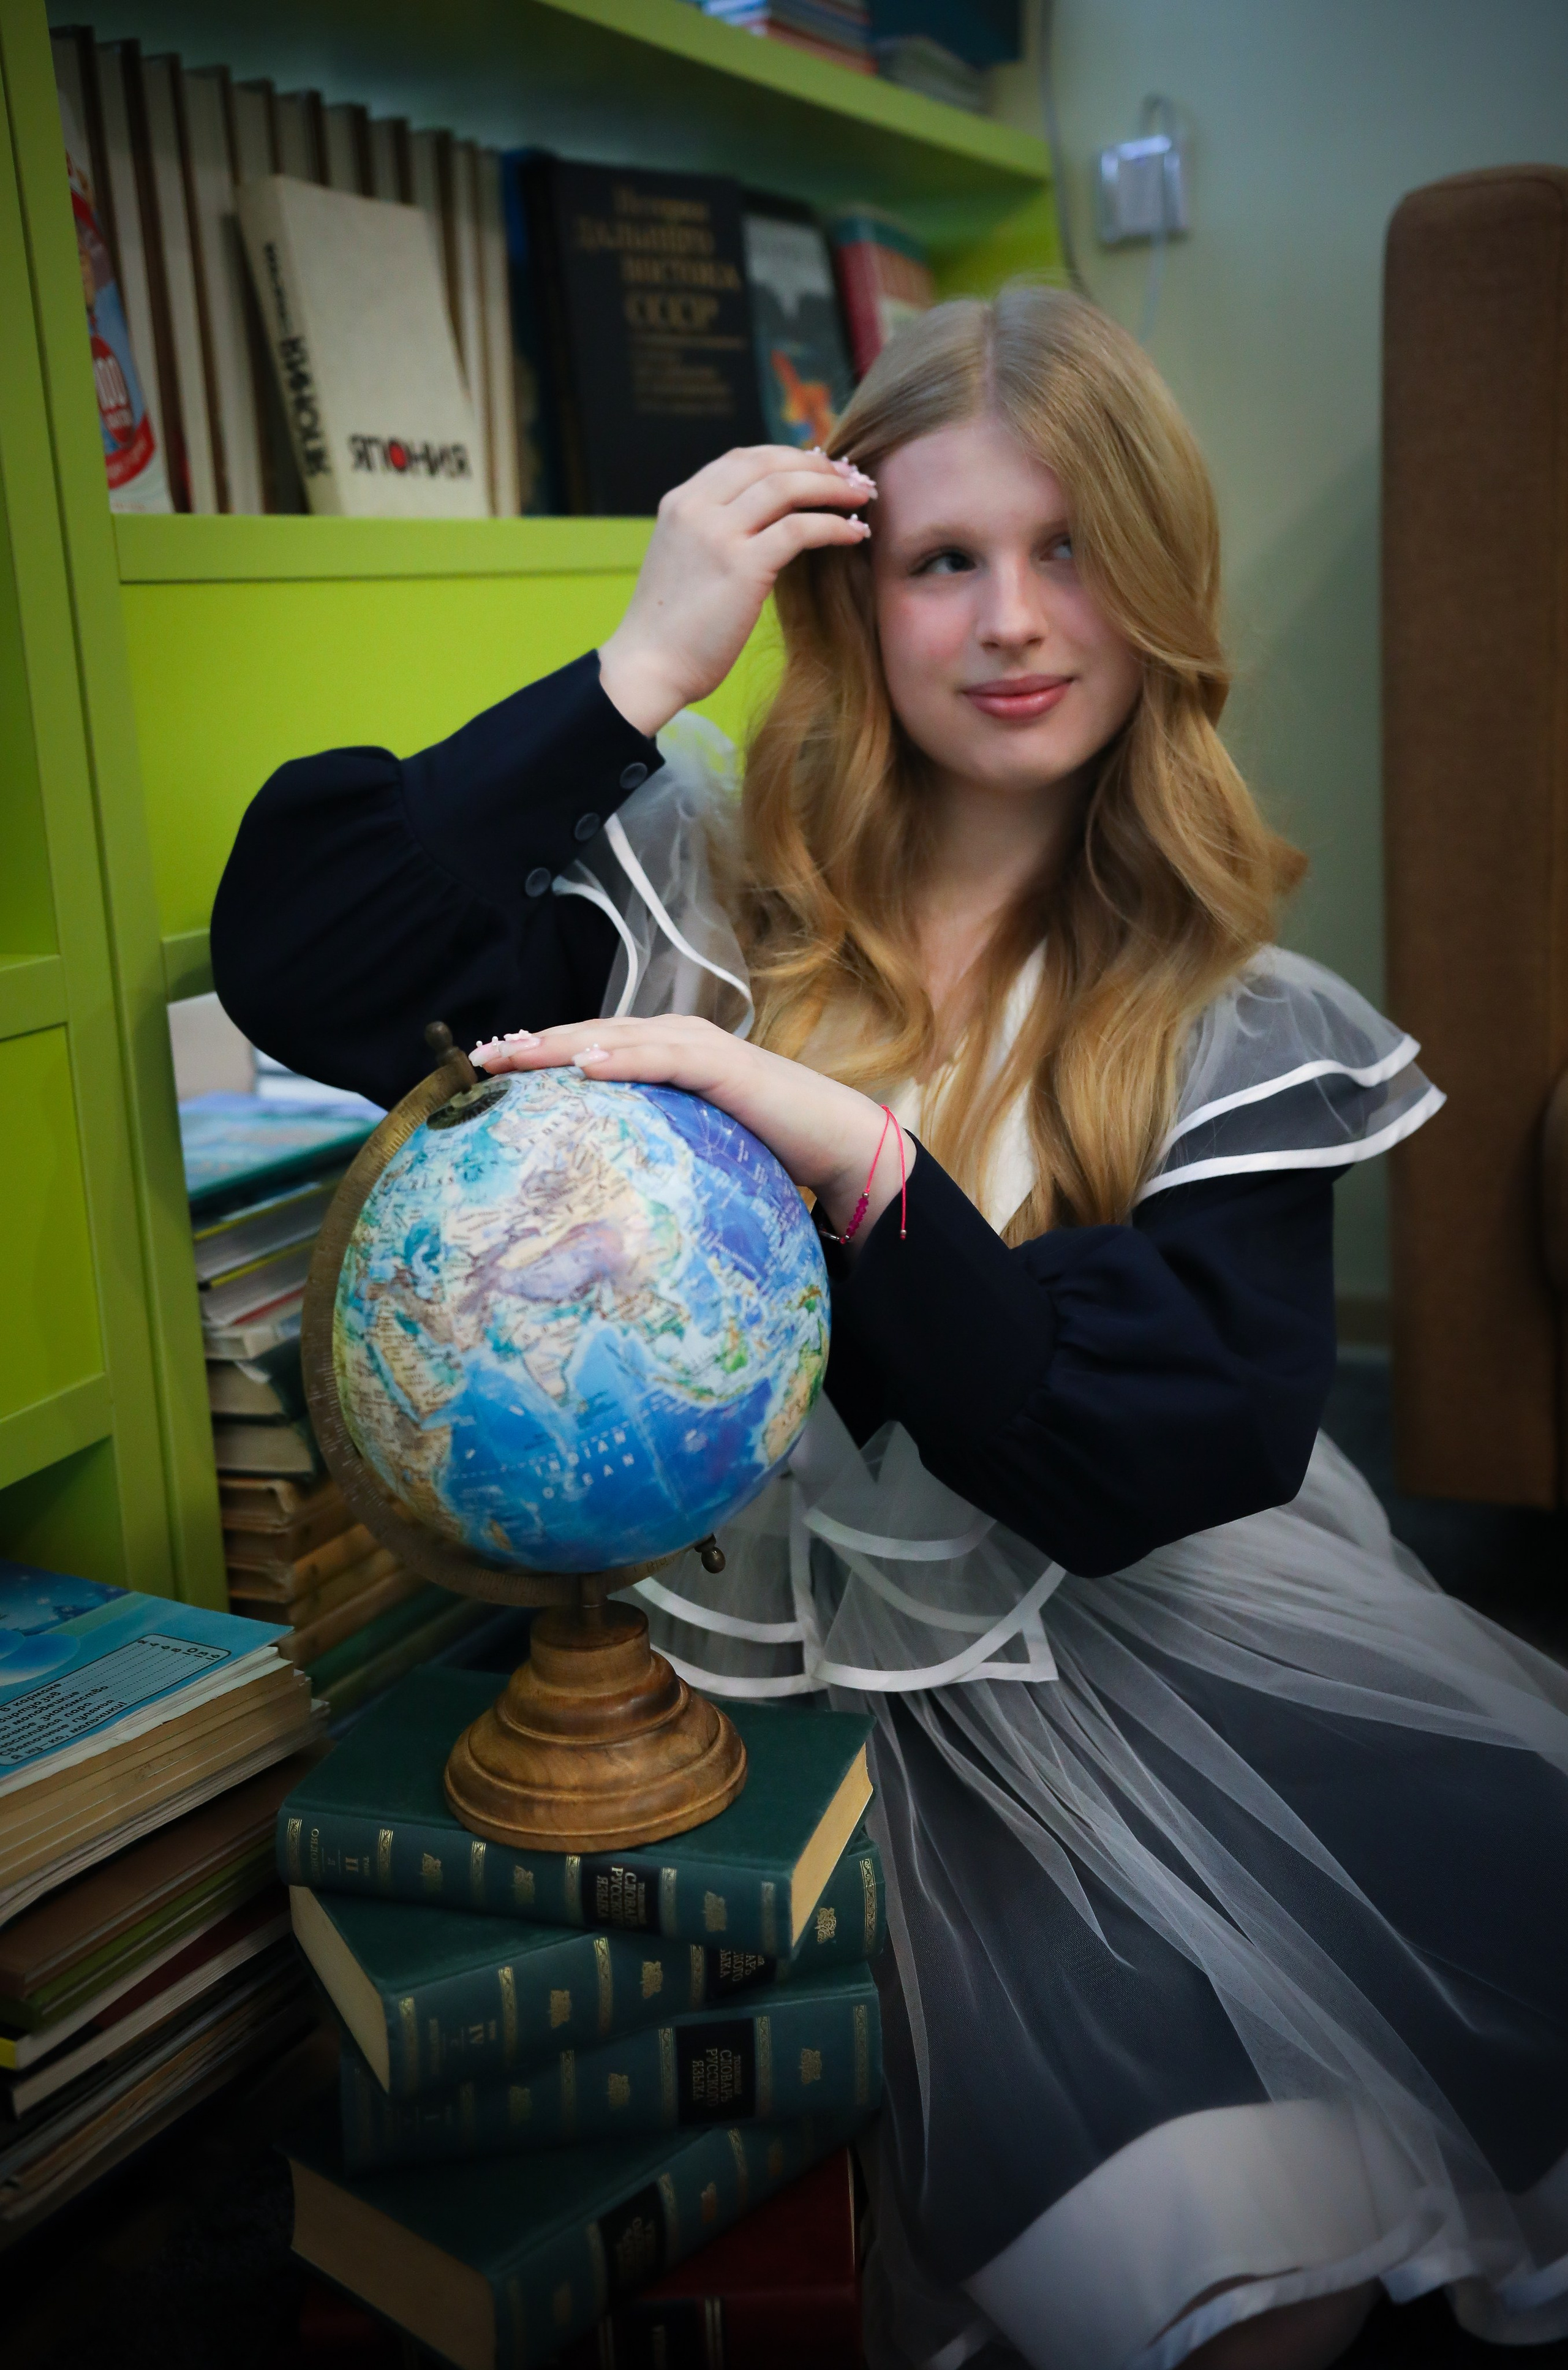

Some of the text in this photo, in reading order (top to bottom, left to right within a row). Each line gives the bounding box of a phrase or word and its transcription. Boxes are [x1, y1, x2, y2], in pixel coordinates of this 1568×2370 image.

[347, 432, 474, 479] ЯПОНИЯ
[534, 1432, 626, 1477] INDIAN
[0, 1722, 36, 1740] очное
[40, 1686, 109, 1721] знакомство
[12, 1691, 80, 1725] молодецкие
[13, 1683, 62, 1707] кармане
[70, 1700, 127, 1734] мальчики!
[72, 1699, 116, 1723] гулянья
[0, 1718, 62, 1749] частливая
[64, 1702, 93, 1718] пара
[597, 1874, 609, 1919] ЯЗЫКА
[611, 1866, 624, 1928] РУССКОГО
[625, 1872, 638, 1928] СЛОВАРЬ
[732, 1950, 744, 1982] КОГО
[692, 2060, 704, 2101] ЯЗЫКА
[706, 2048, 718, 2107] РУССКОГО
[720, 2050, 733, 2102] СЛОВАРЬ
